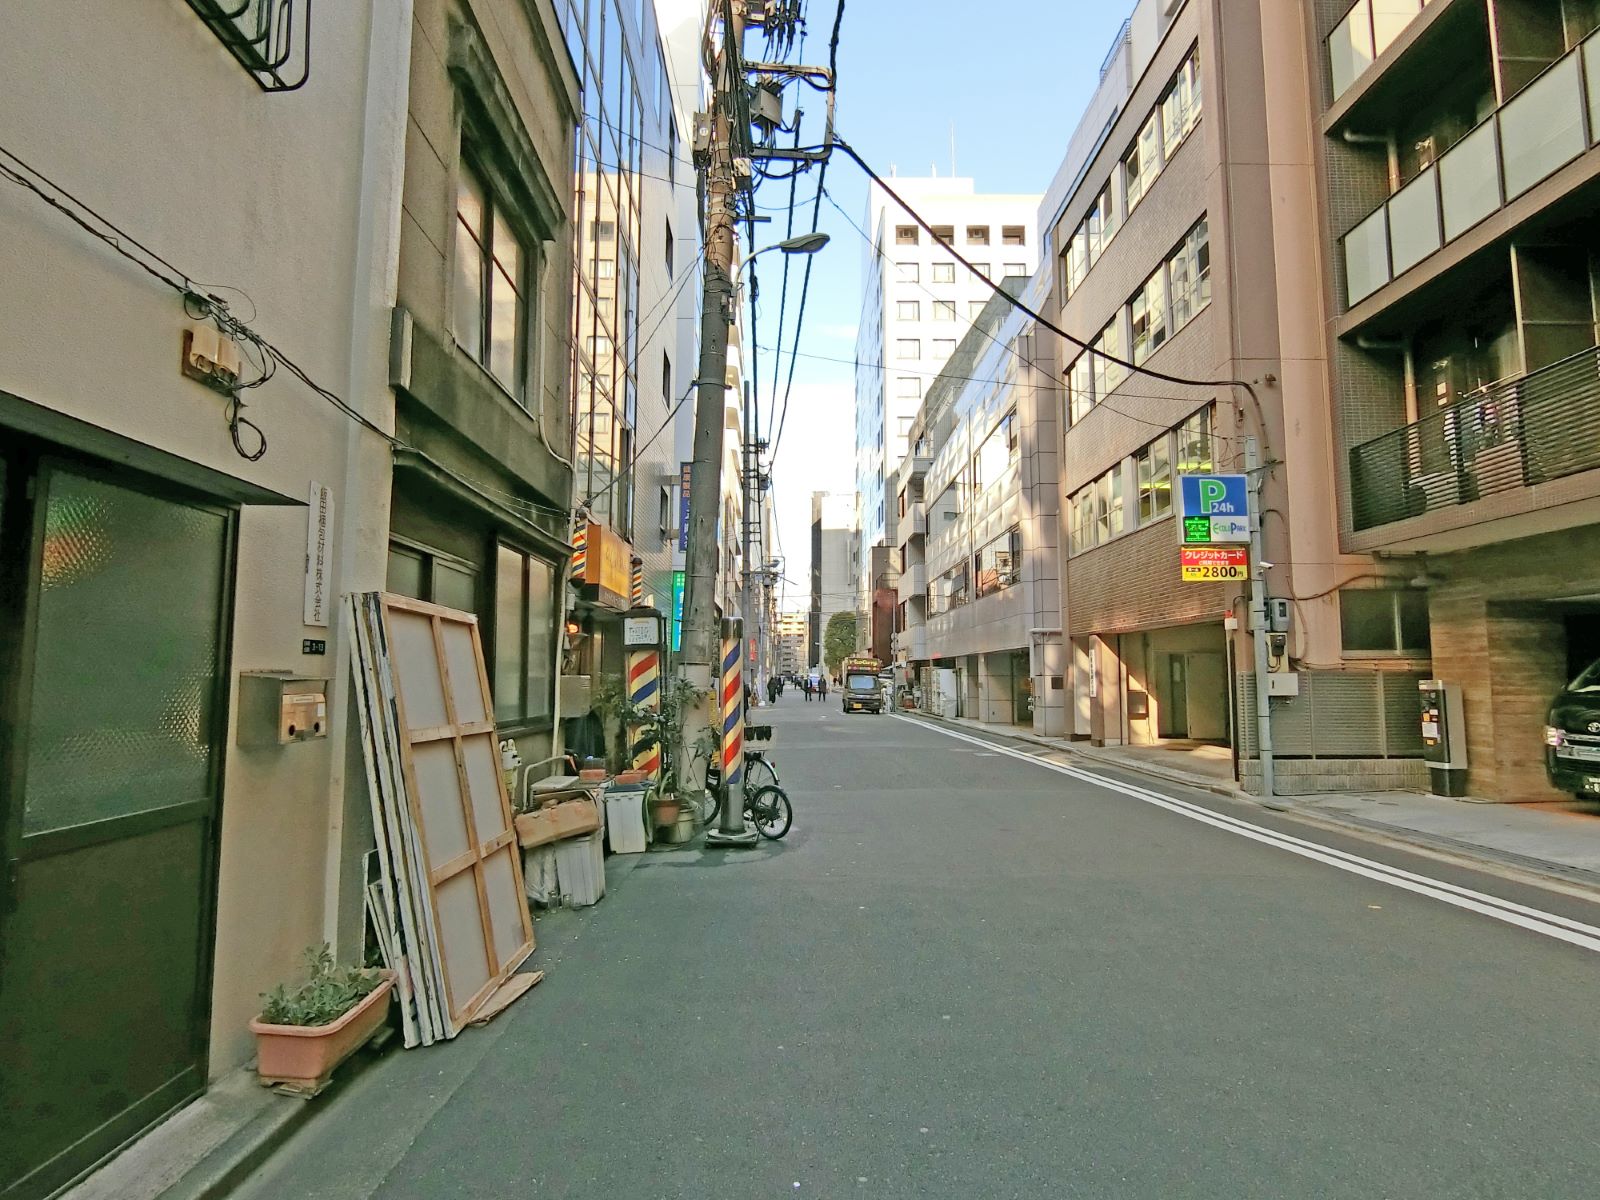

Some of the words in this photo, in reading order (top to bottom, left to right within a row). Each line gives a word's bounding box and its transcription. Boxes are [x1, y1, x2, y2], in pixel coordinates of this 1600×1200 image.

[1199, 479, 1226, 513] P
[1212, 502, 1235, 513] 24h
[1184, 551, 1243, 560] クレジットカード
